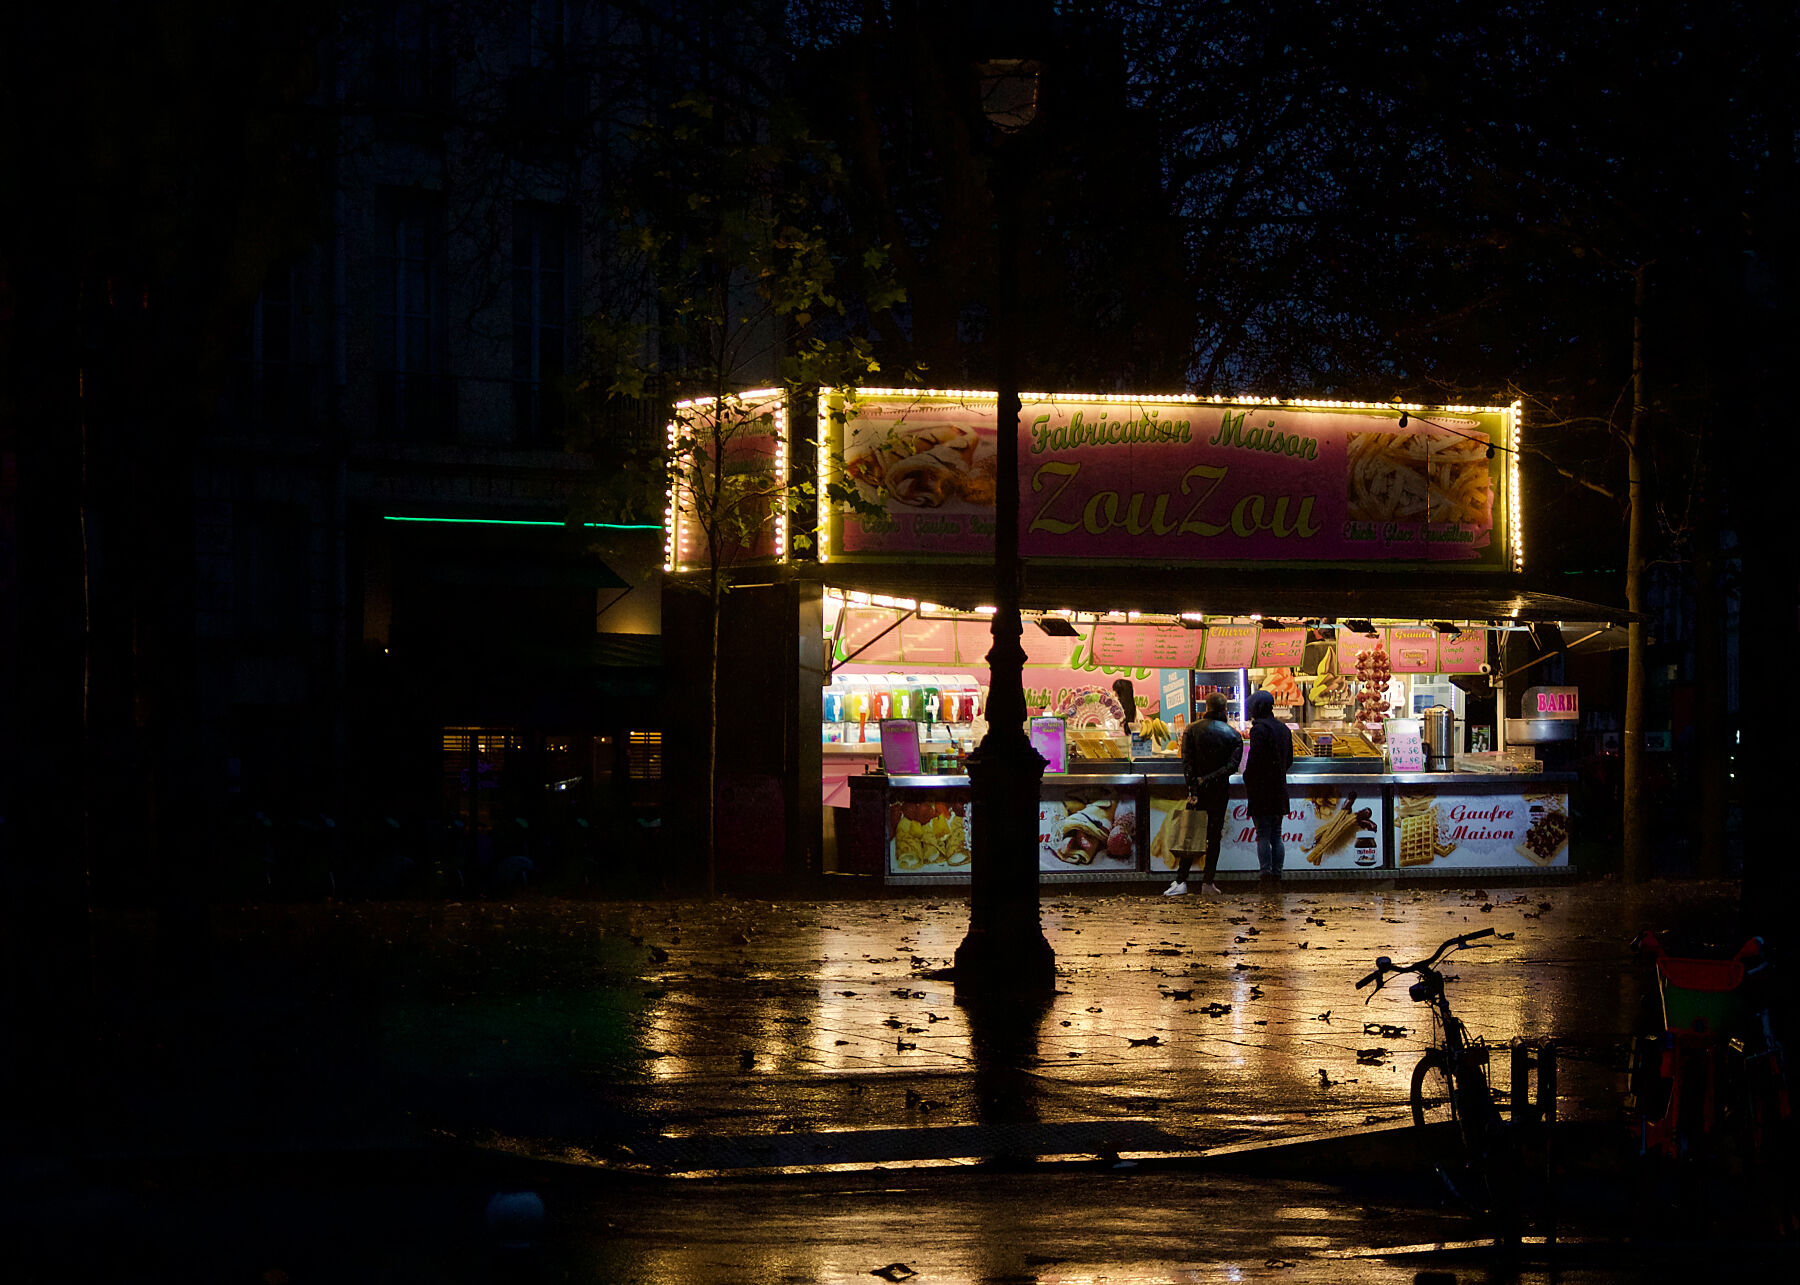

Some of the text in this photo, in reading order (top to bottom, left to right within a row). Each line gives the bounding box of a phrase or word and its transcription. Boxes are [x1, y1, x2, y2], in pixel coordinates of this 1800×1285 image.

[1030, 409, 1319, 461] Fabrication Maison
[1028, 460, 1323, 538] ZouZou
[1262, 640, 1275, 648] 5€
[1290, 640, 1302, 648] 12
[1261, 649, 1274, 657] 8€
[1288, 649, 1301, 657] 20
[1023, 688, 1051, 708] hichi
[1407, 737, 1418, 745] 3€
[1392, 747, 1401, 755] 15
[1450, 804, 1515, 824] Gaufre
[1233, 827, 1304, 844] Mon
[1451, 825, 1515, 842] Maison
